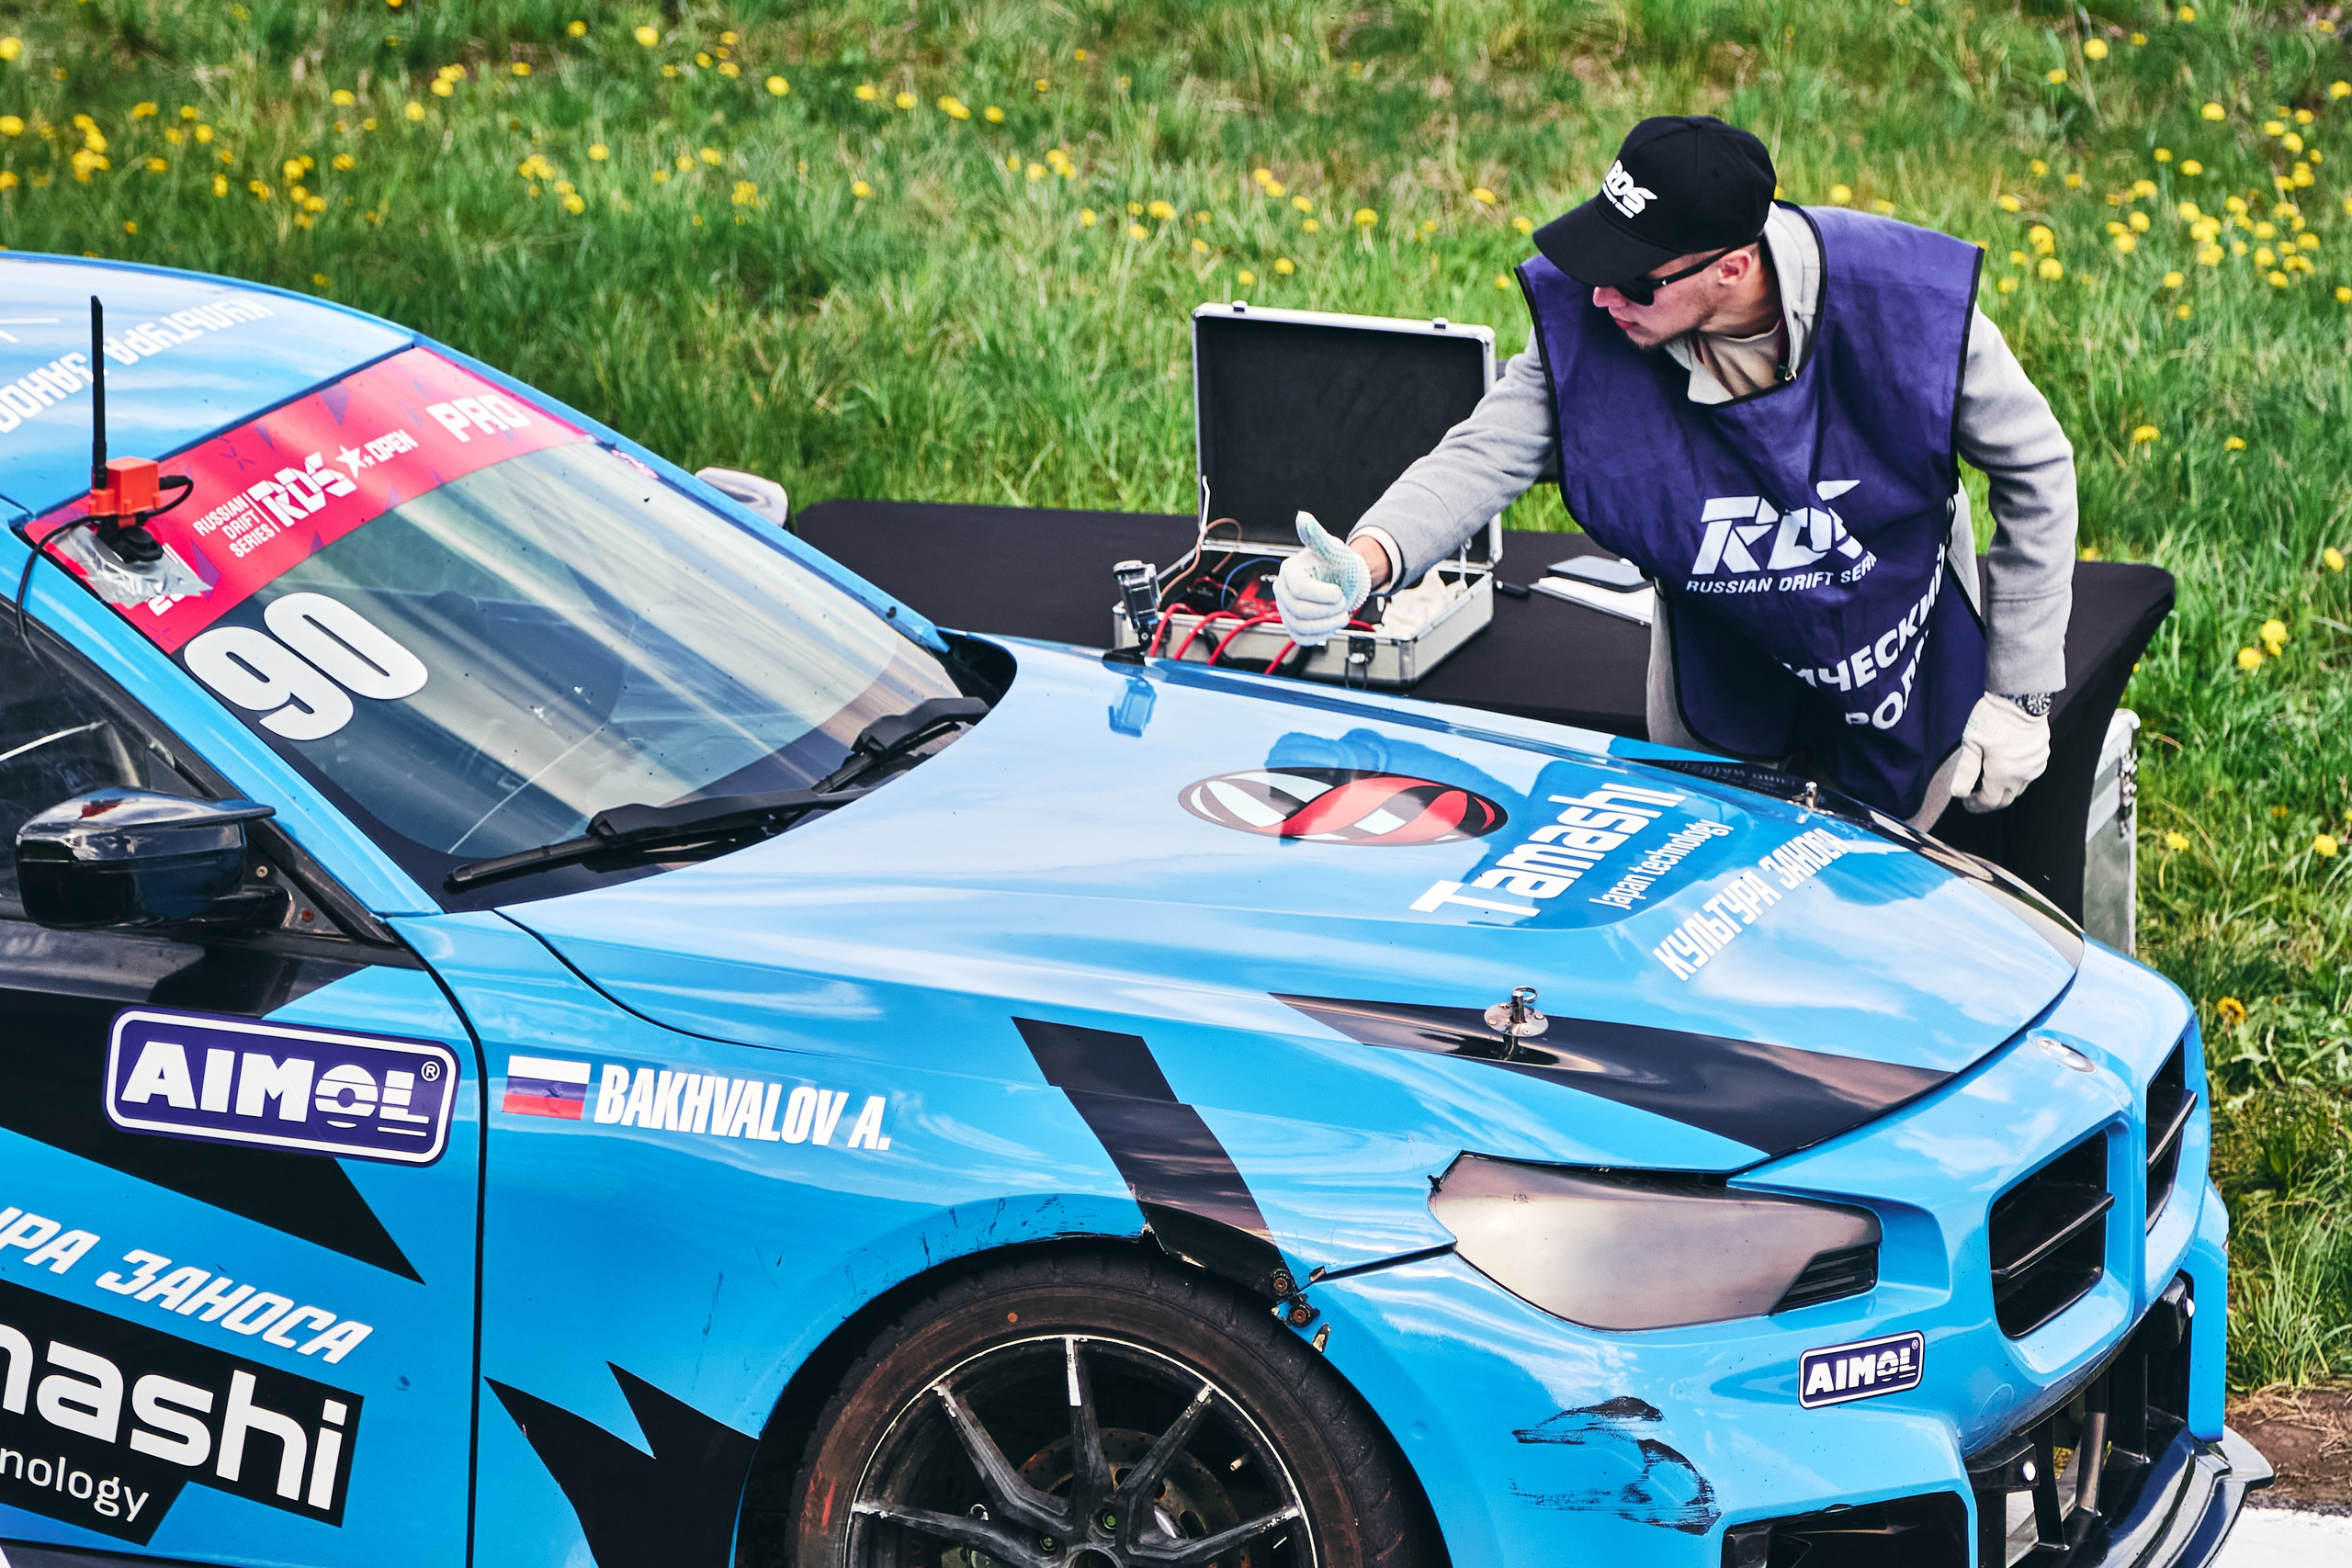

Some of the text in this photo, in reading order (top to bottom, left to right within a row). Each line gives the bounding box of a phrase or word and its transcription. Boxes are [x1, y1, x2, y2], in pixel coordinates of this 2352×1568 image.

[1604, 159, 1658, 215] RDS
[425, 394, 532, 443] PRO
[192, 494, 250, 537] RUSSIAN
[246, 429, 419, 528] RDS OPEN
[221, 509, 261, 540] DRIFT
[229, 523, 276, 558] SERIES
[1686, 577, 1772, 594] RUSSIAN
[1779, 571, 1834, 592] DRIFT
[184, 592, 429, 741] 90
[1408, 783, 1687, 918] Tamashi
[1589, 818, 1735, 910] Japan technology
[1652, 828, 1854, 982] КУЛЬТУРА ЗАНОСА
[594, 1064, 891, 1151] BAKHVALOV A.
[95, 1249, 374, 1364] ЗАНОСА
